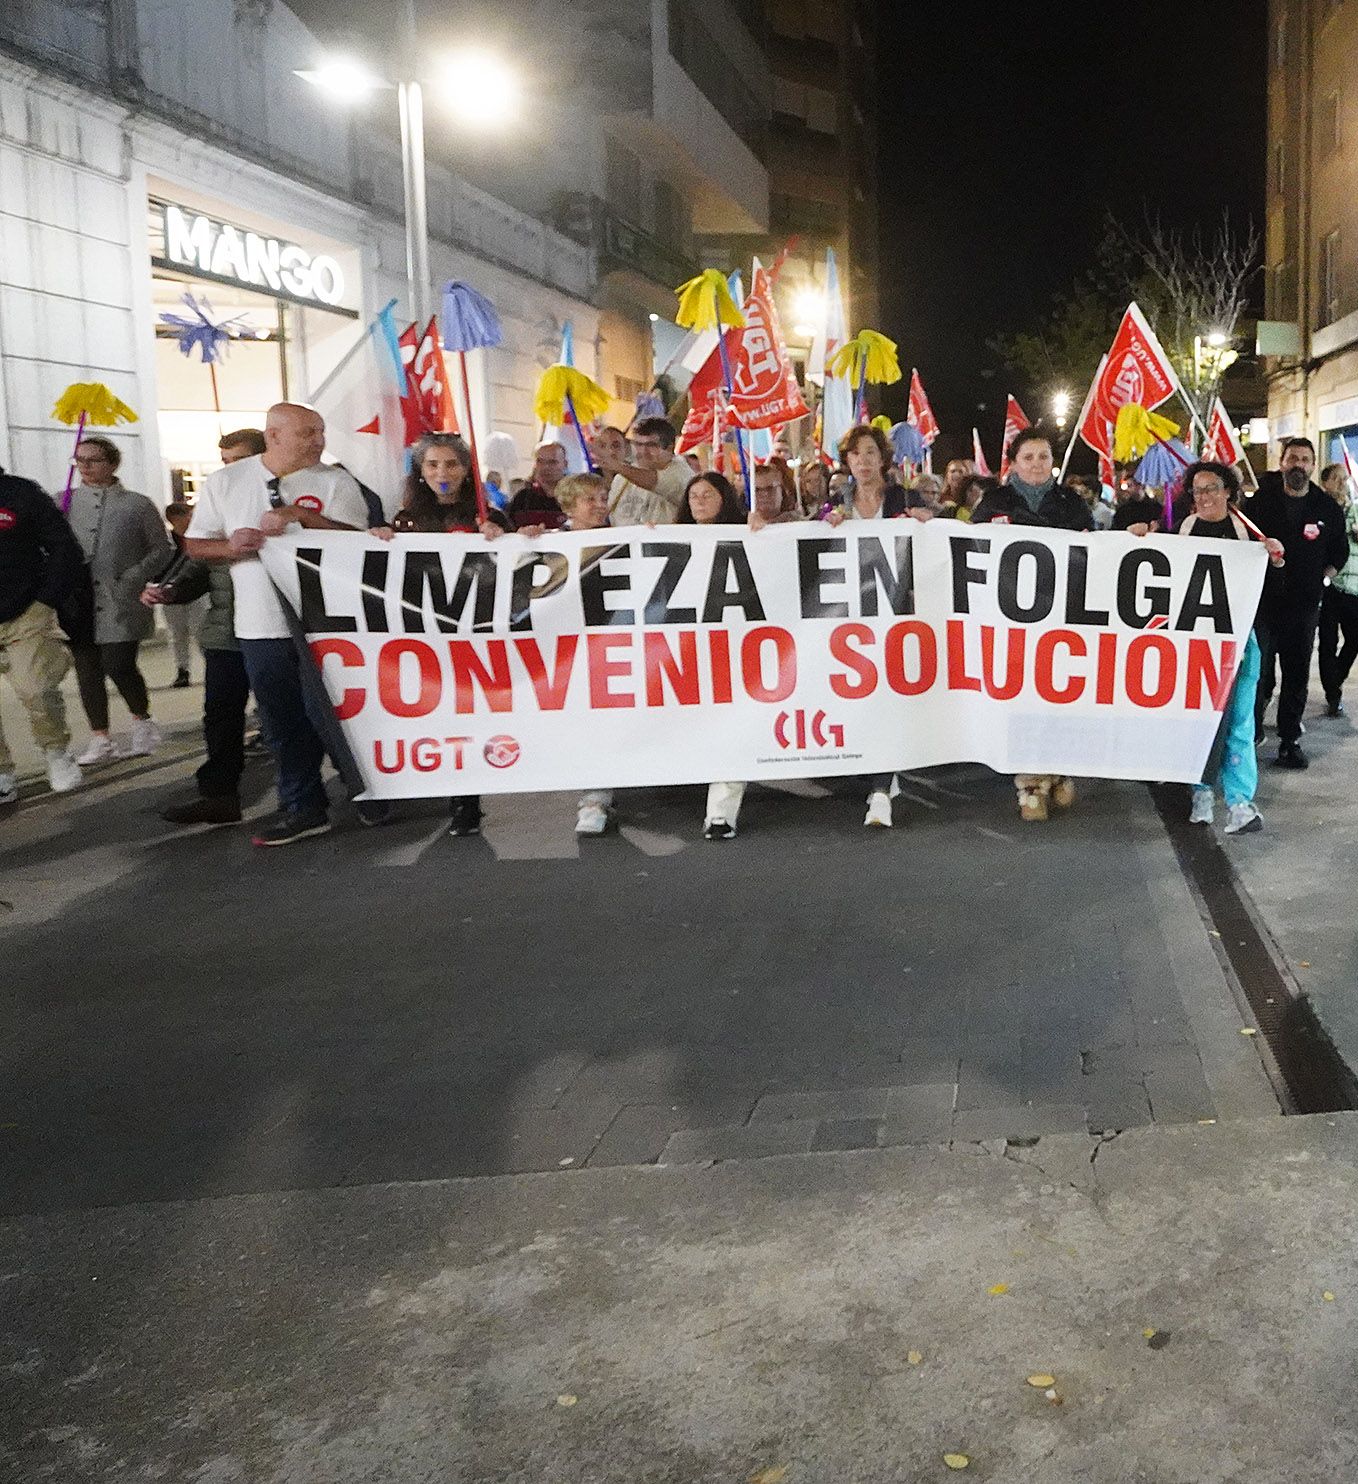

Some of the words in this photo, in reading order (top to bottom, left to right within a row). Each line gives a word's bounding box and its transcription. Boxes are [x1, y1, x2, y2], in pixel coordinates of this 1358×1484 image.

[166, 206, 345, 306] MANGO
[295, 538, 767, 634] LIMPEZA
[796, 534, 916, 620] EN
[949, 536, 1234, 635] FOLGA
[309, 625, 798, 721] CONVENIO
[828, 616, 1238, 712] SOLUCIÓN
[373, 736, 473, 774] UGT
[774, 709, 844, 749] CIG
